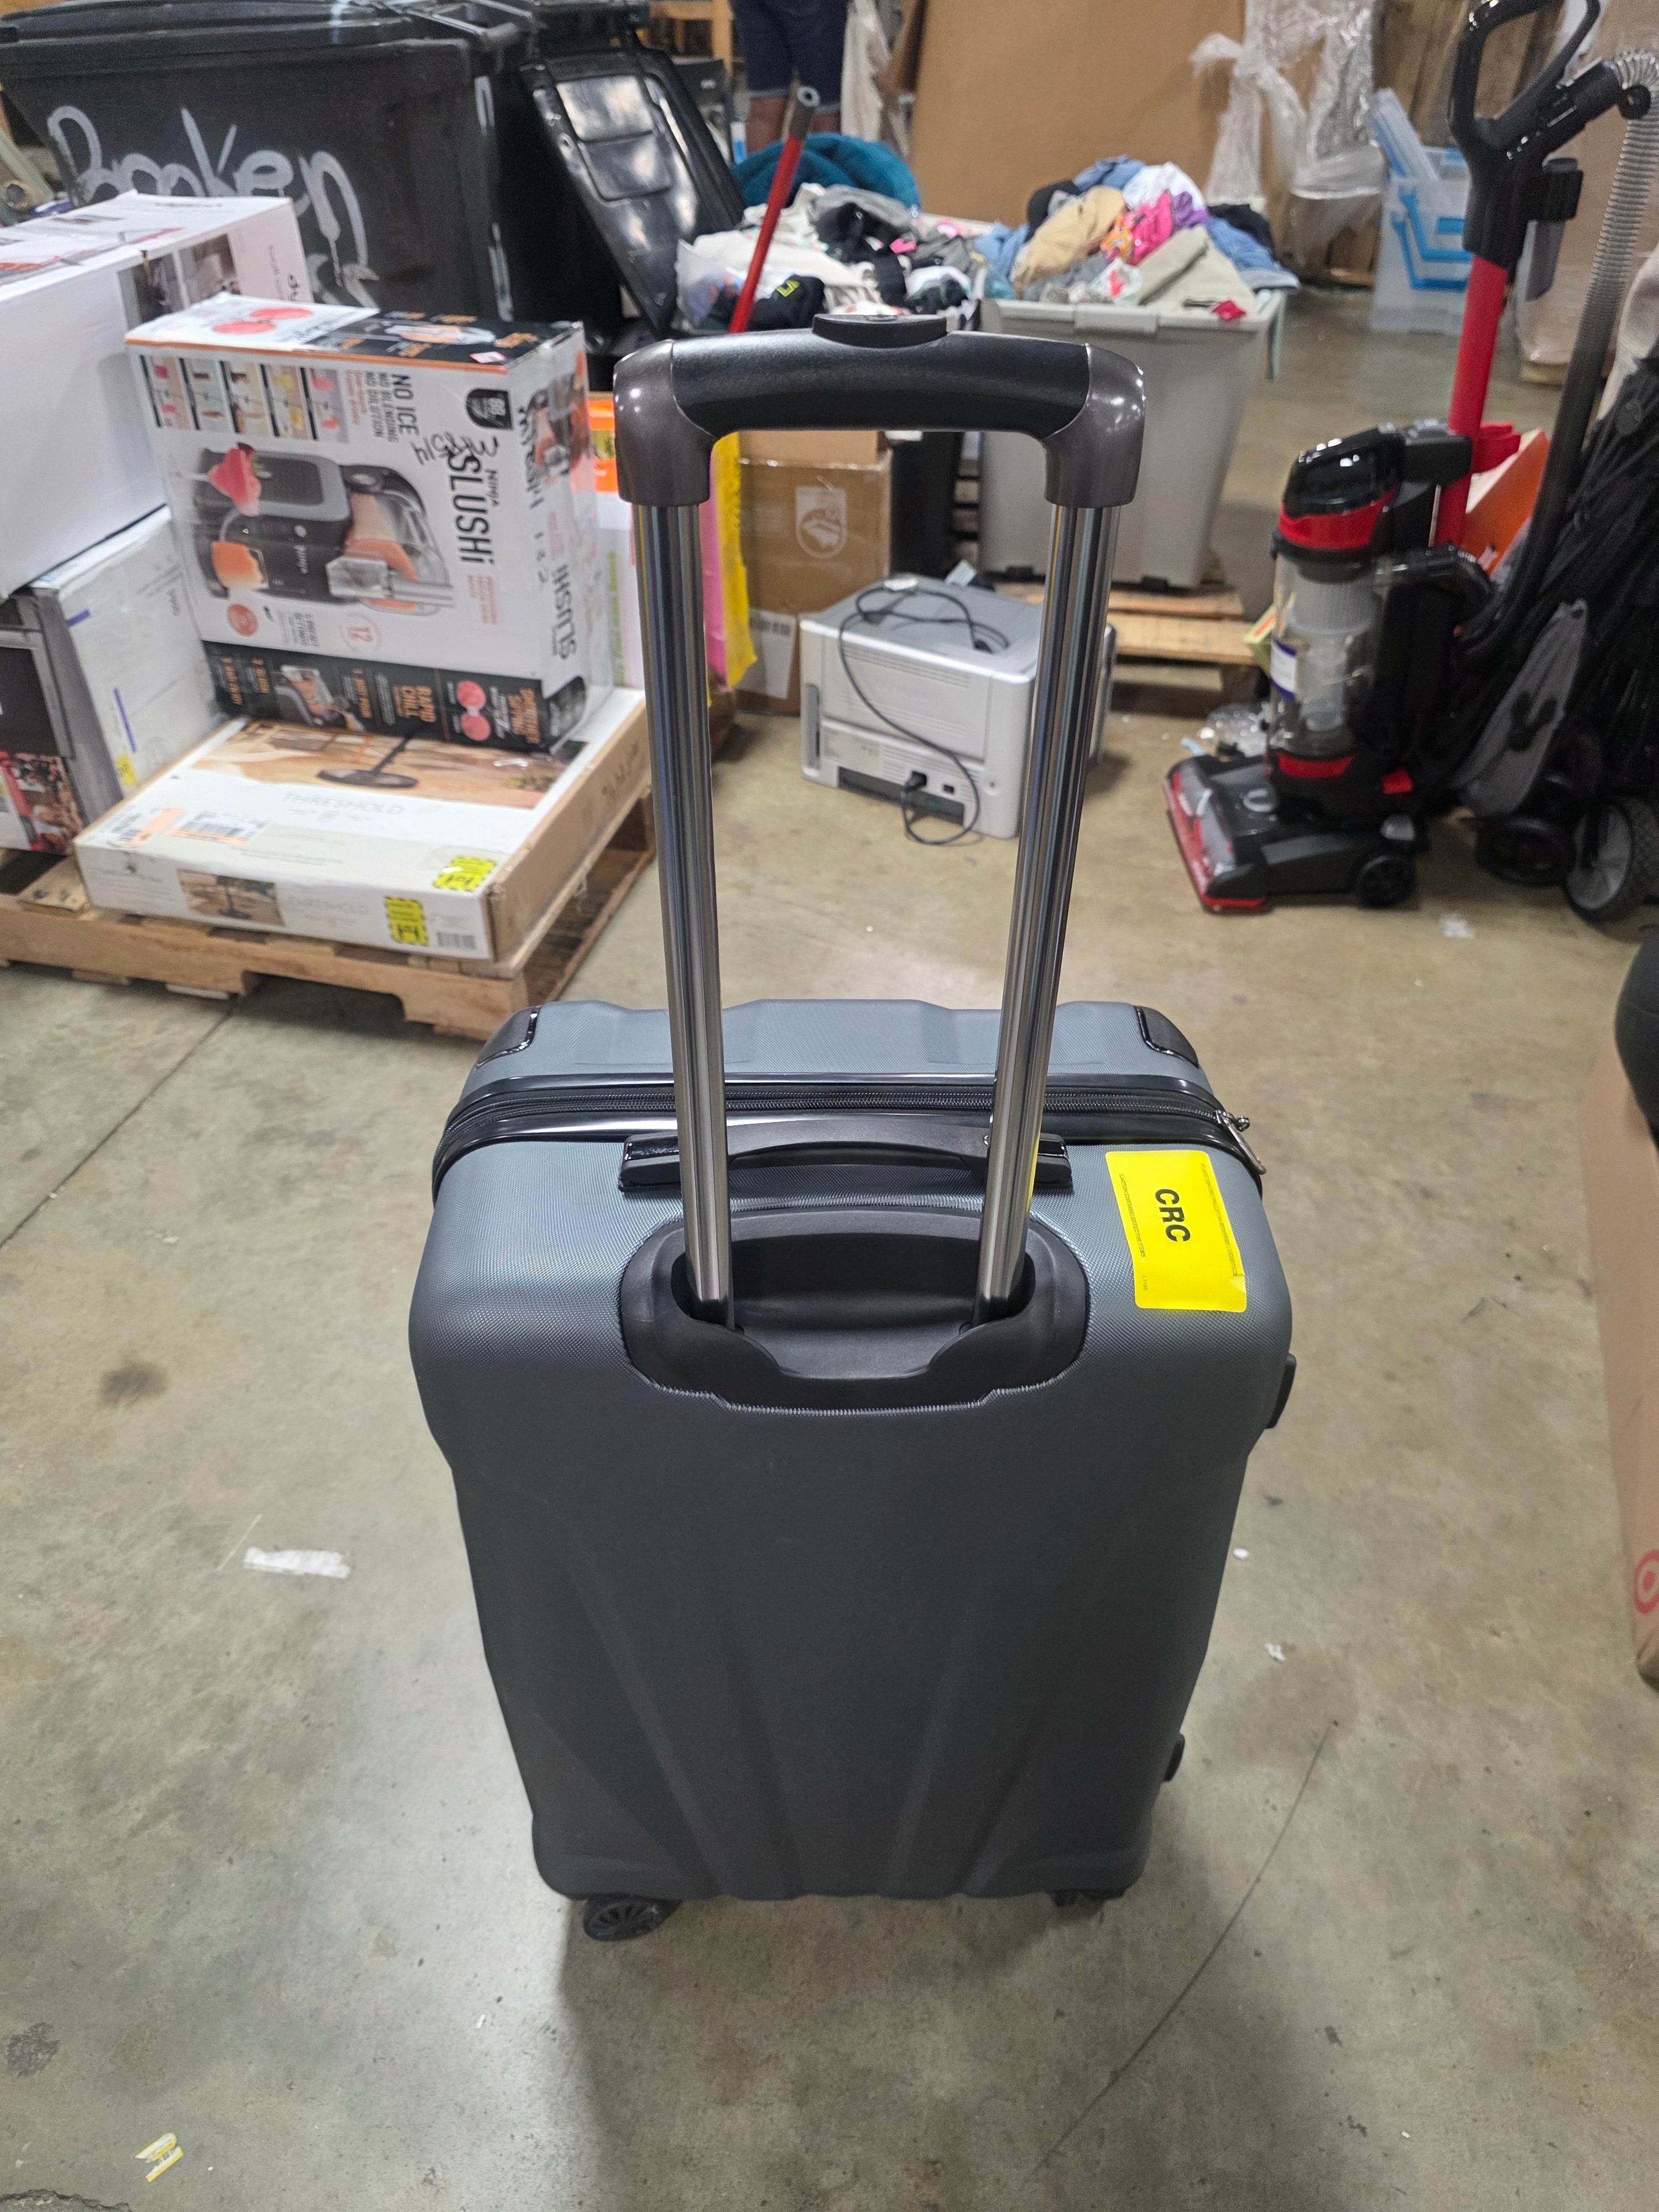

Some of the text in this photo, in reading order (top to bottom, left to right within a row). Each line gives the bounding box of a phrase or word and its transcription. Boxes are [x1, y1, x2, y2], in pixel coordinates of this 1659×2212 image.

[392, 373, 420, 436] NO ICE
[447, 451, 495, 565] SLUSHi
[485, 469, 500, 507] NINJA
[1155, 1188, 1191, 1242] CRC
